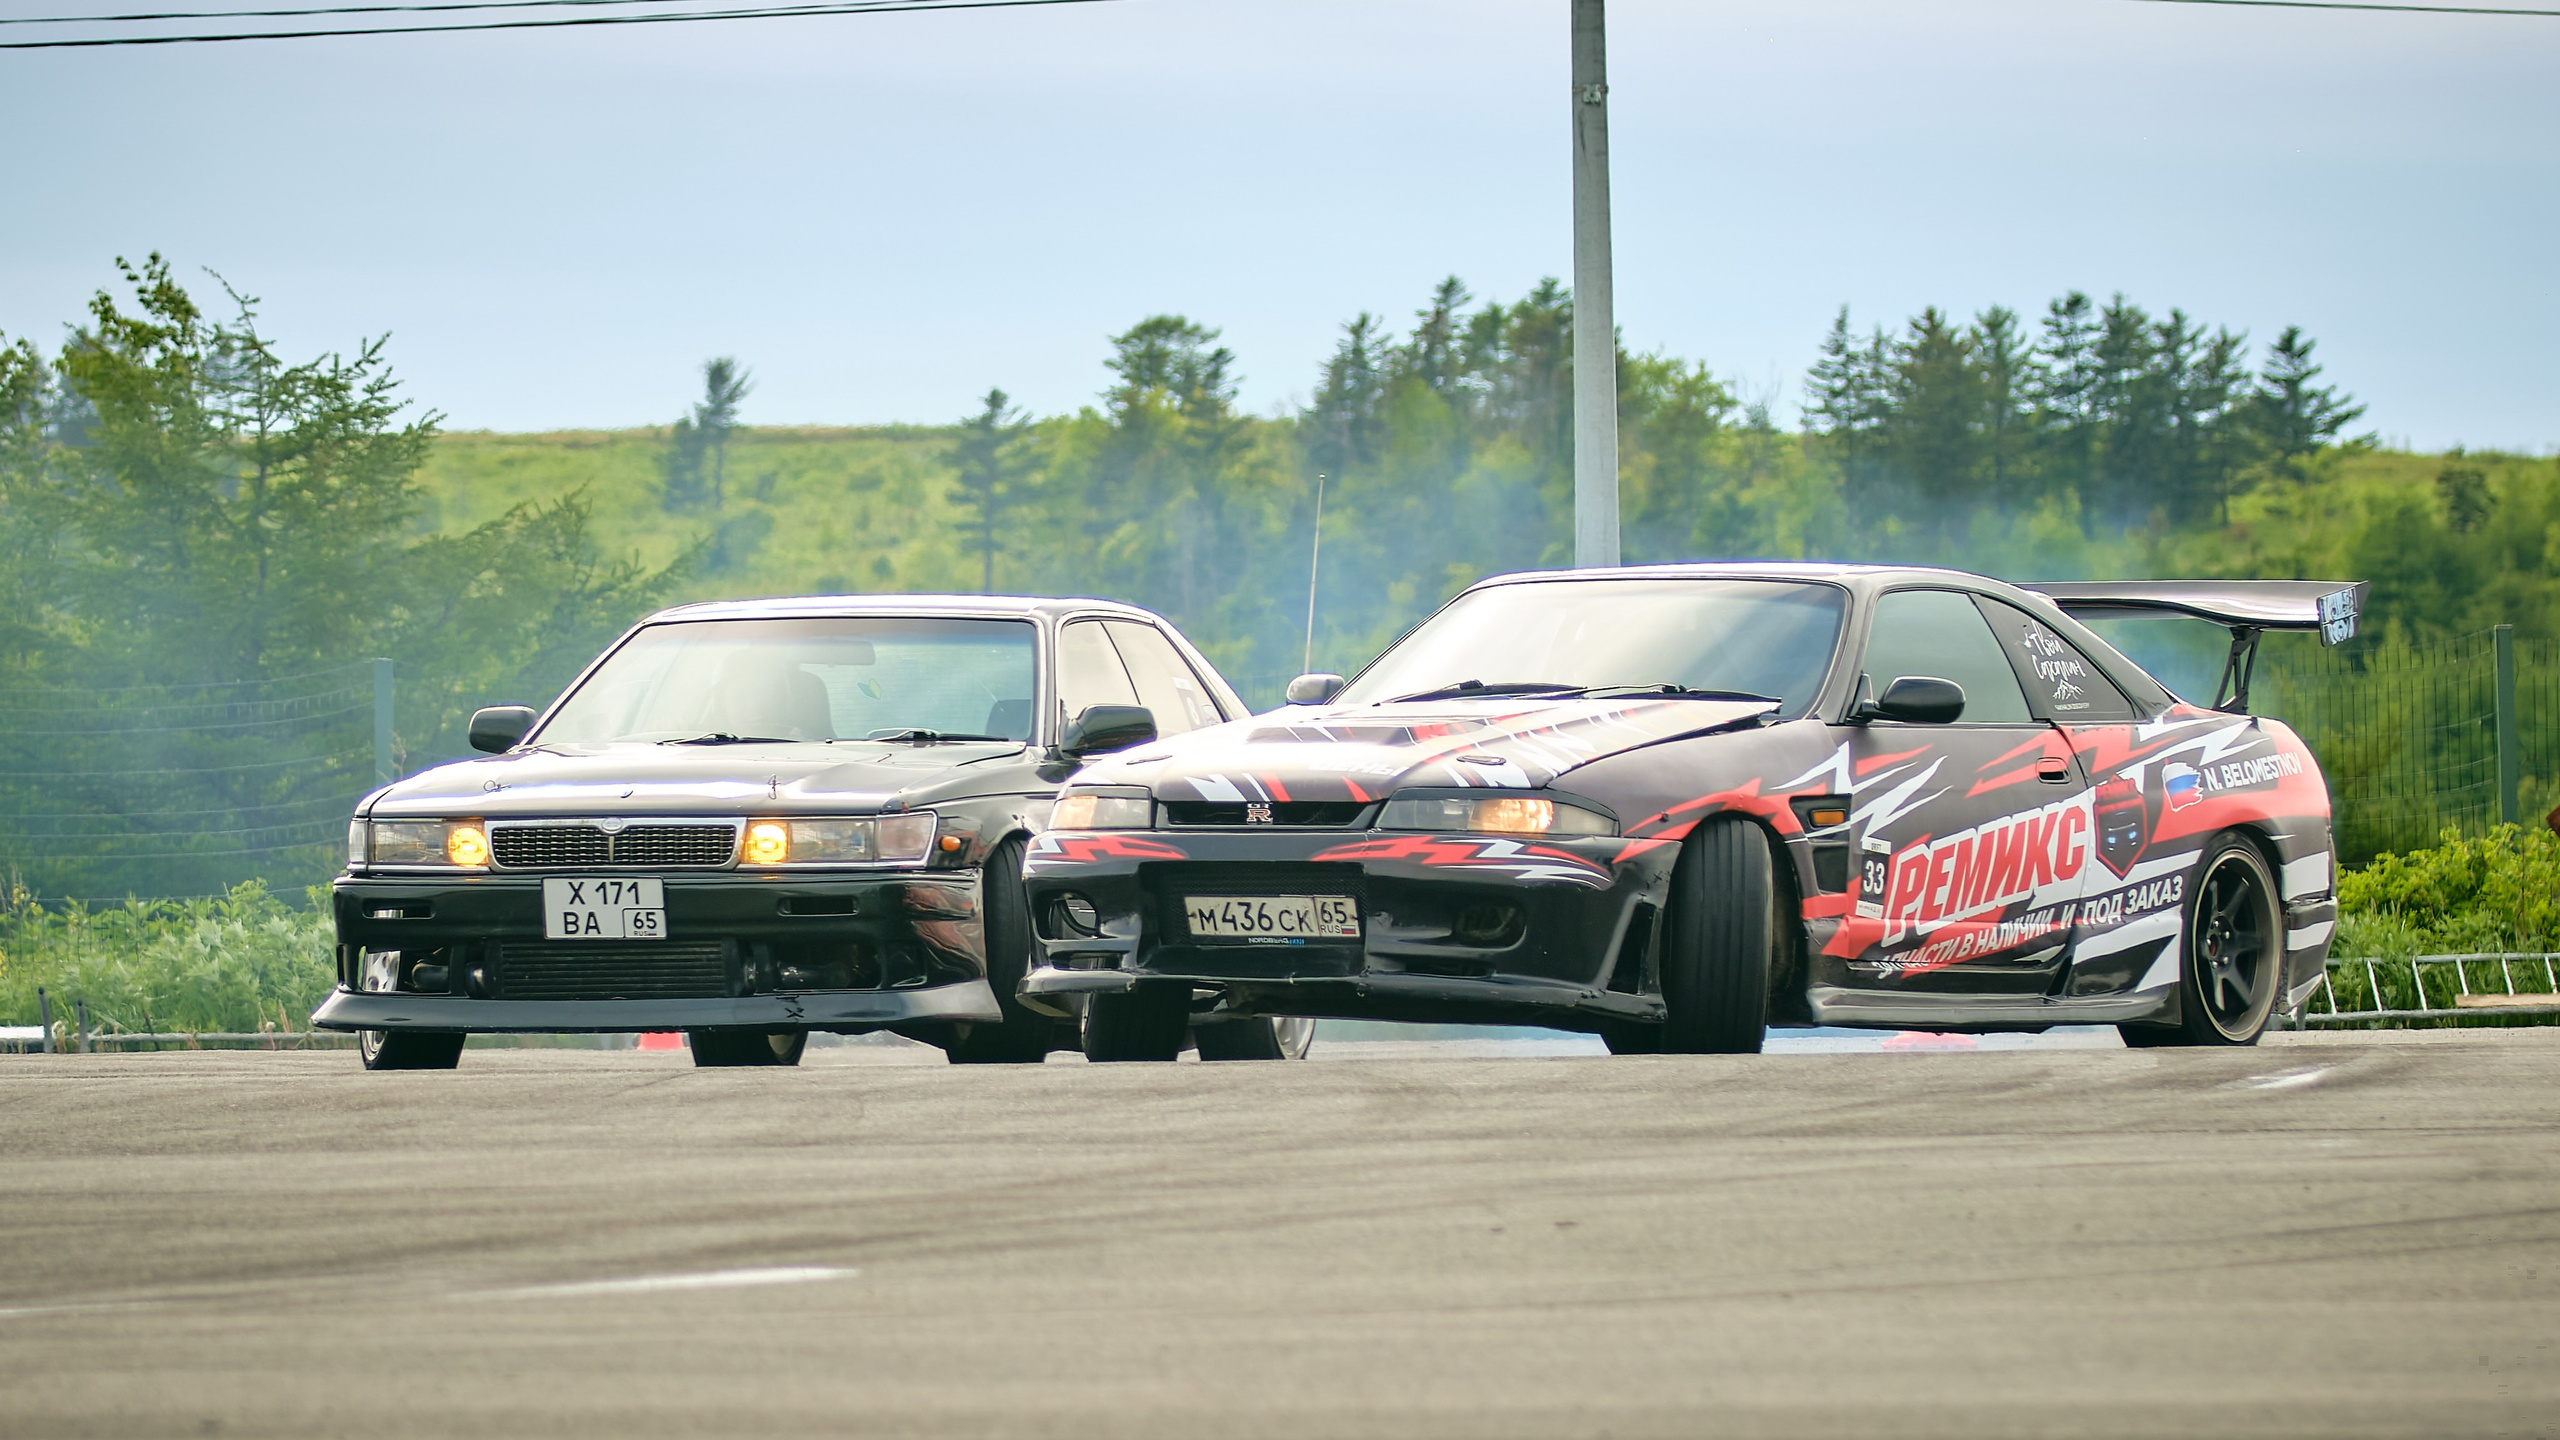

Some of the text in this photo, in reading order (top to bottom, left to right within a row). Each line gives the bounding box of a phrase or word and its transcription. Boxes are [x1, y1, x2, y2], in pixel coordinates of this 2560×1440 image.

[2204, 752, 2303, 791] N. BELOMESTNOV
[1863, 860, 1885, 894] 33
[1886, 803, 2087, 943] РЕМИКС
[595, 881, 640, 905] 171
[563, 911, 657, 934] ВА 65
[1320, 902, 1347, 924] 65
[1956, 933, 1974, 958] В
[1972, 908, 2055, 955] НАЛИЧИИ
[2060, 903, 2077, 930] И
[2082, 892, 2124, 926] ПОД
[2124, 875, 2183, 915] ЗАКАЗ
[1320, 925, 1341, 934] RUS
